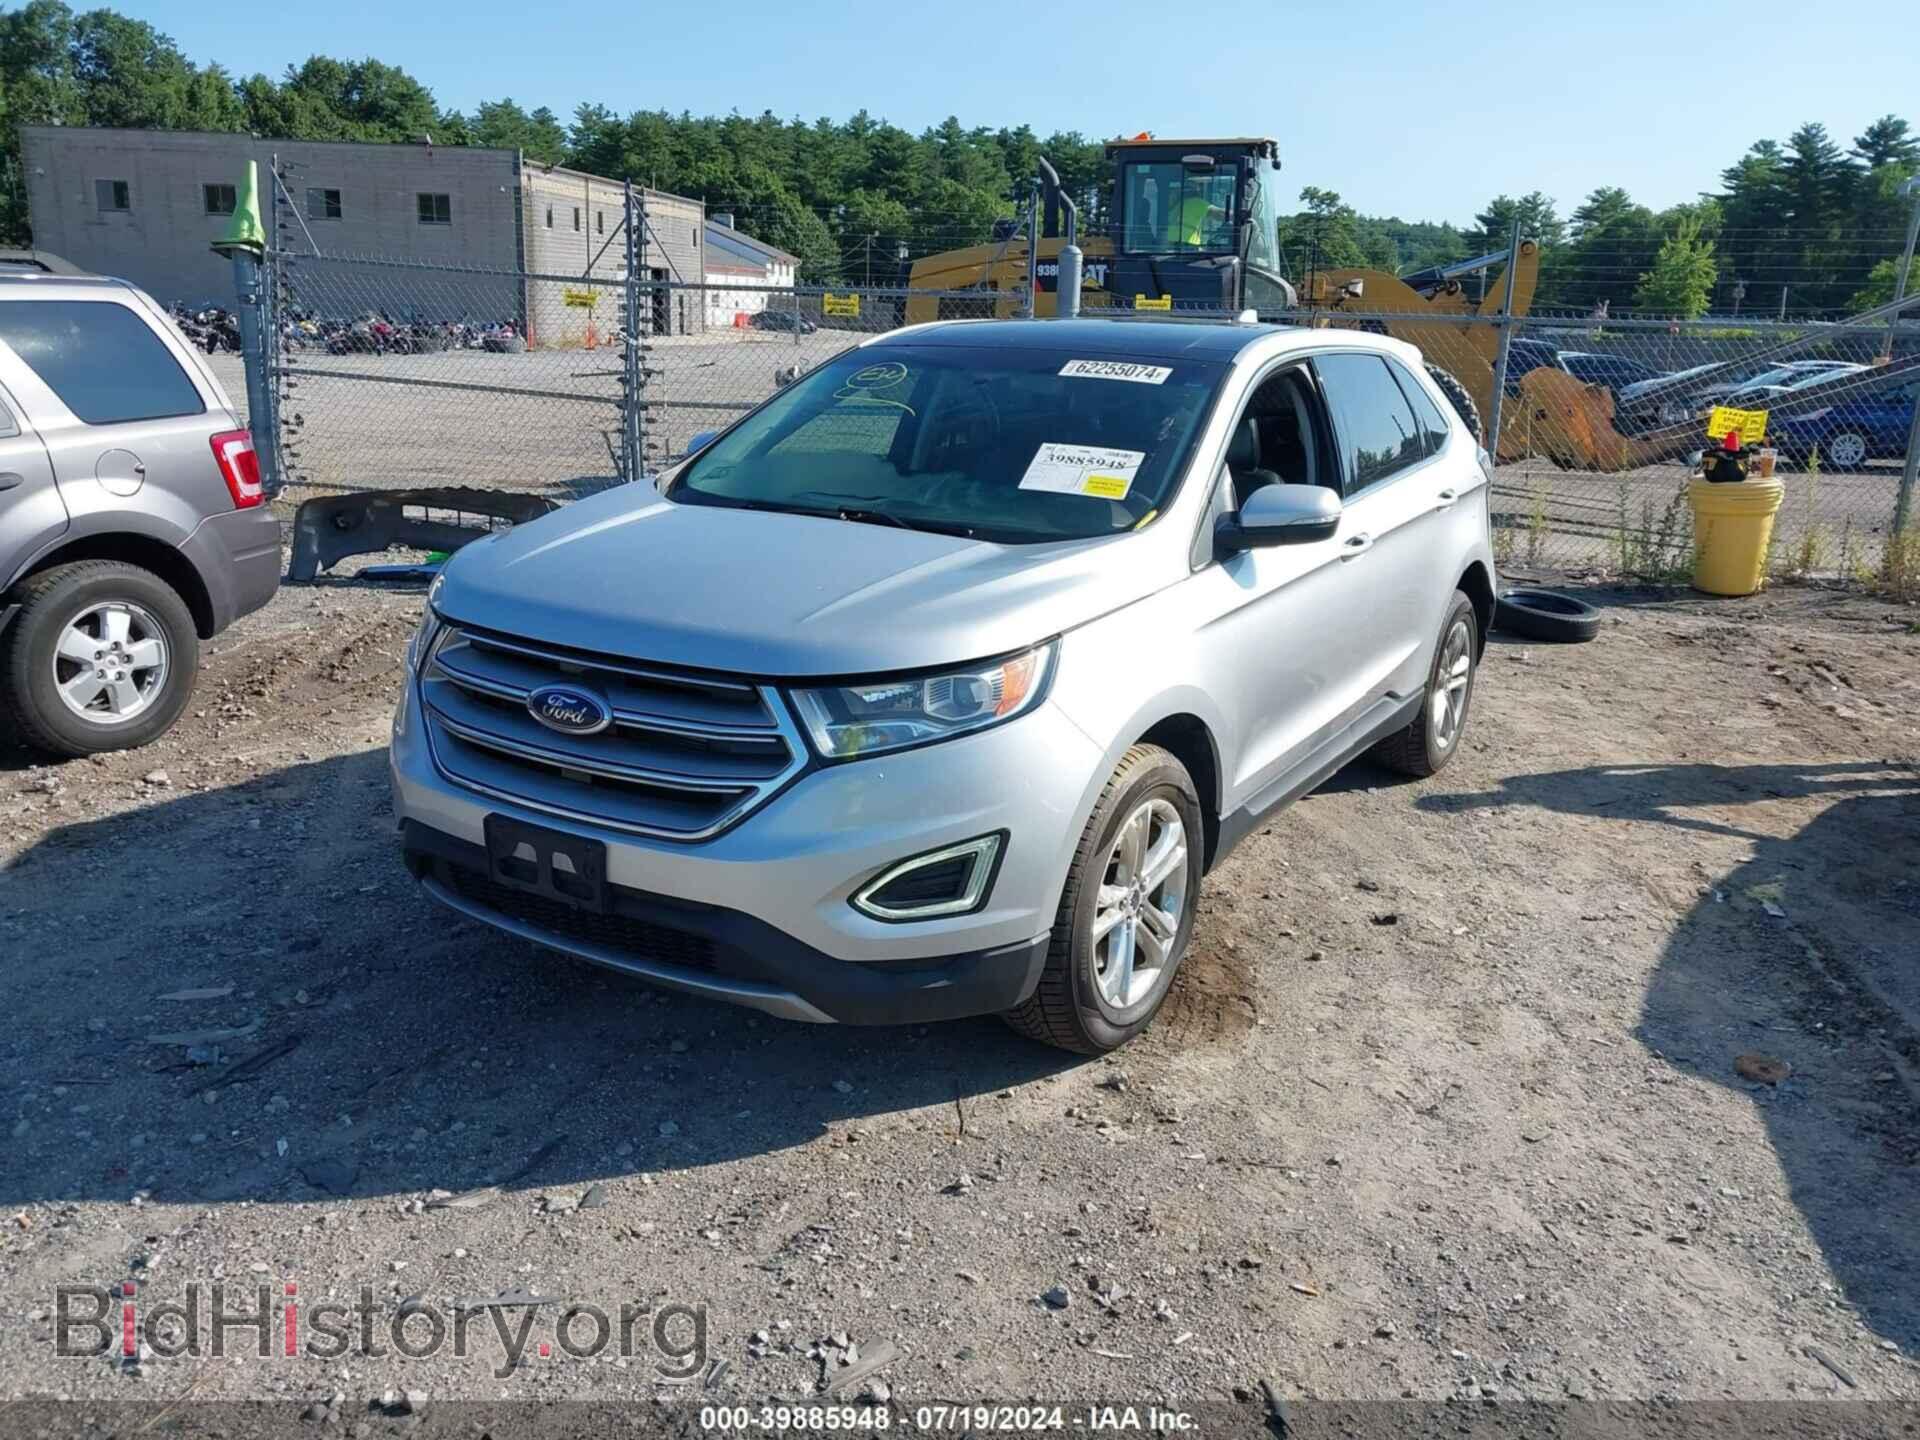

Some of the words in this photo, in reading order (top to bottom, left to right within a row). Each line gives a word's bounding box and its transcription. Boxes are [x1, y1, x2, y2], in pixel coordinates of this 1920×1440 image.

[1037, 264, 1059, 277] 938
[1081, 263, 1108, 288] AT
[1075, 361, 1157, 379] 62255074
[1048, 453, 1128, 470] 39885948
[542, 694, 587, 724] Ford
